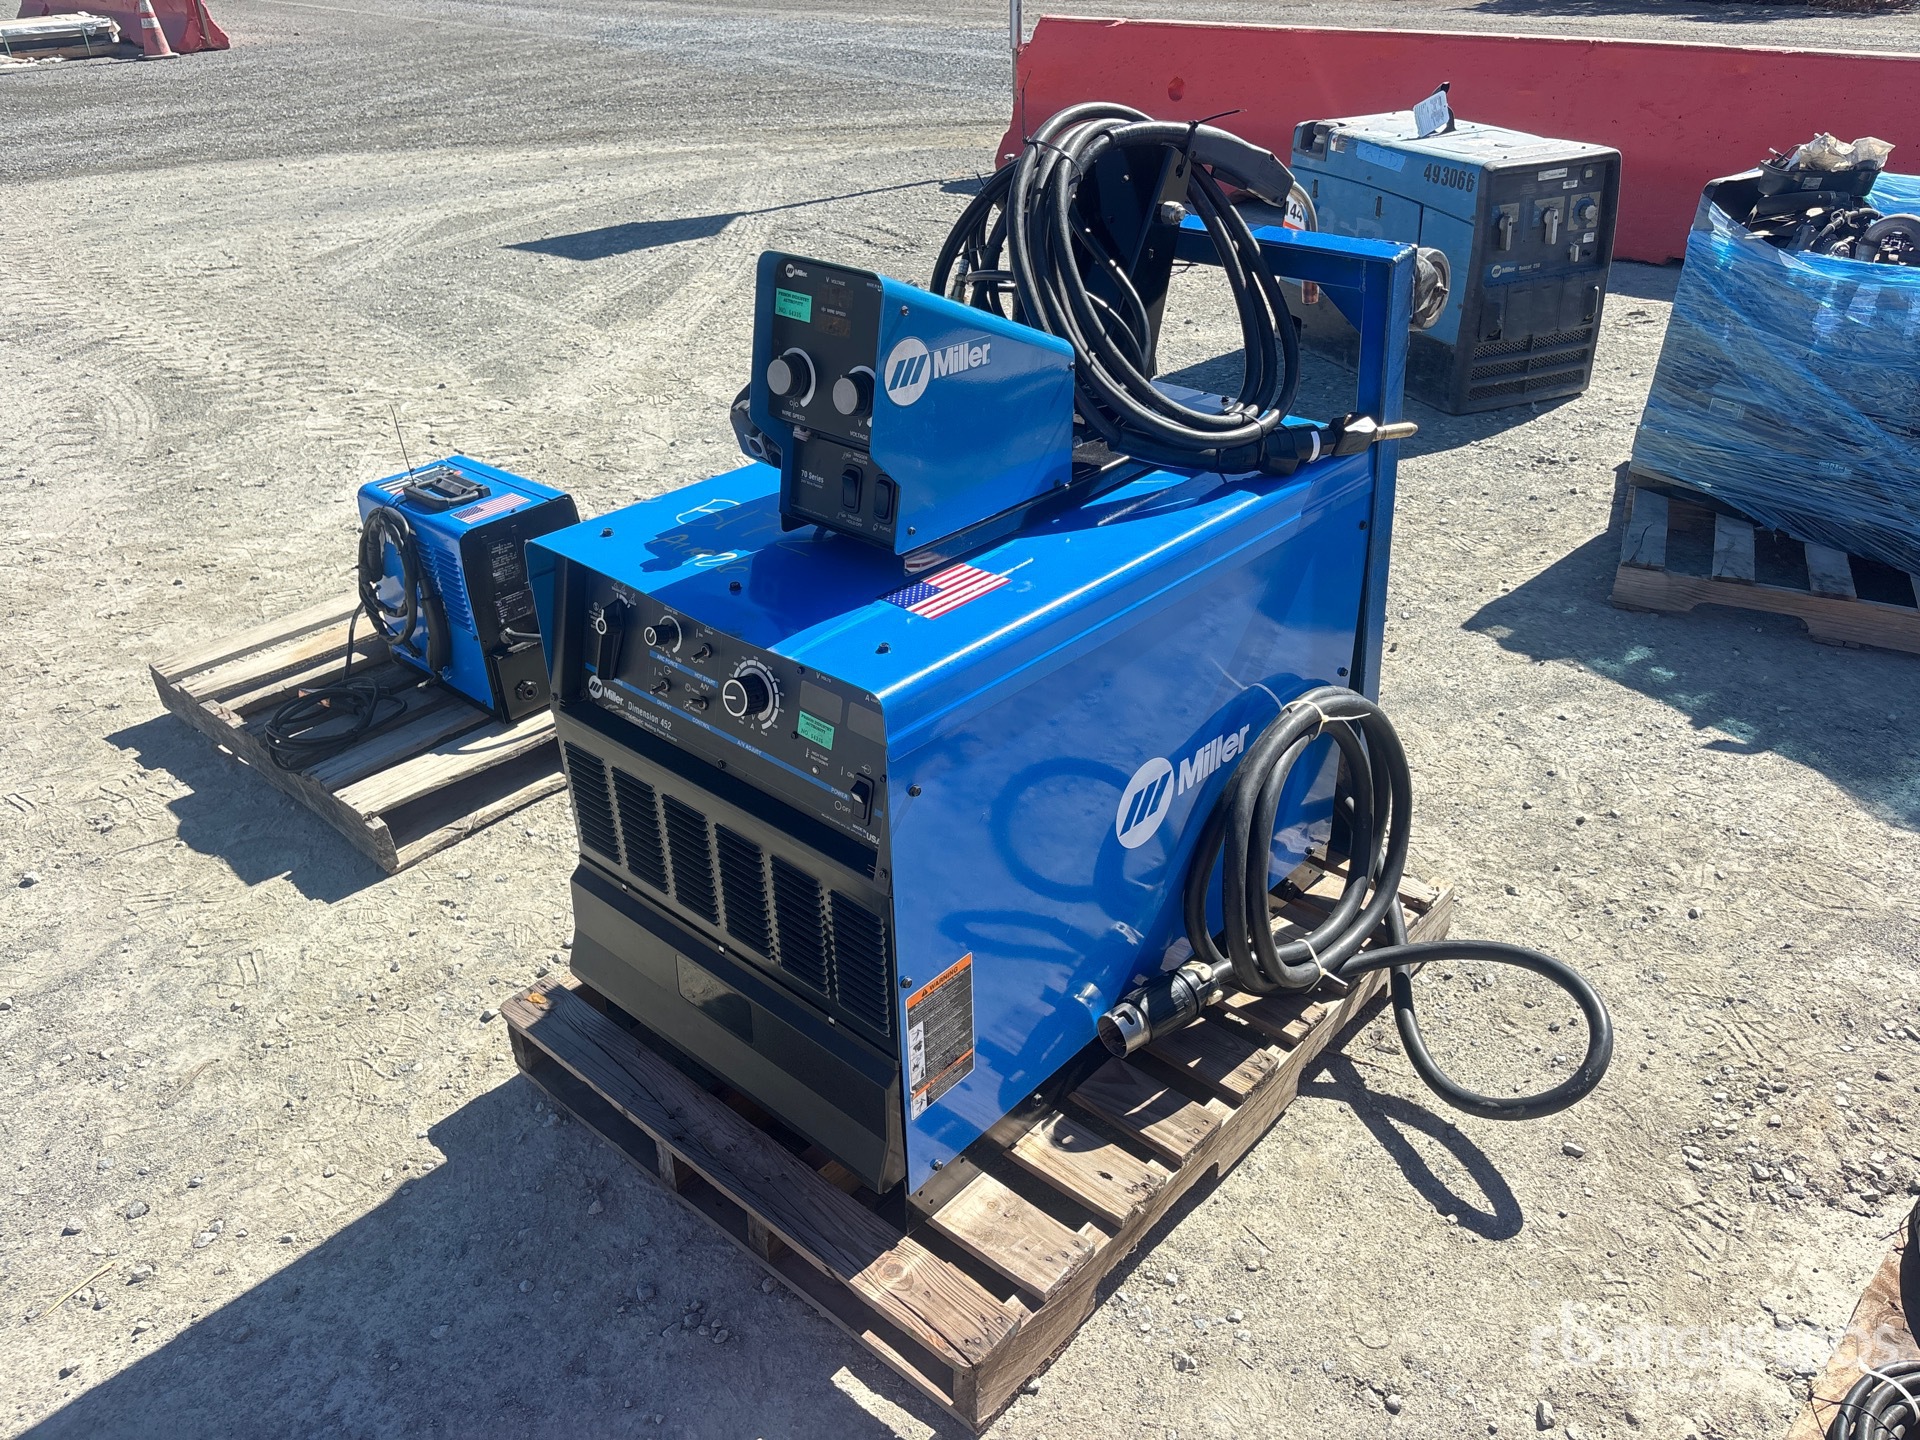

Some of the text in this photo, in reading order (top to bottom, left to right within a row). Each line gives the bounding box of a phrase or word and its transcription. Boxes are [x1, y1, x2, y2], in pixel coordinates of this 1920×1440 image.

[1423, 163, 1476, 193] 493066
[794, 268, 808, 278] Miller
[831, 278, 846, 287] VOLTAGE
[933, 342, 992, 380] Miller
[782, 409, 806, 422] WIRE SPEED
[849, 430, 869, 440] VOLTAGE
[801, 469, 824, 483] 70 Series
[656, 654, 679, 669] ARC FORCE
[694, 671, 716, 686] HOT START
[816, 671, 821, 680] V
[700, 682, 710, 691] A/V
[603, 686, 625, 706] Miller
[656, 699, 672, 711] OUTPUT
[627, 701, 672, 731] Dimension 452
[691, 717, 711, 730] CONTROL
[745, 743, 761, 755] ADJUST
[1177, 723, 1251, 797] Miller
[846, 771, 855, 779] ON
[830, 786, 848, 800] POWER
[842, 805, 851, 814] OFF
[929, 966, 959, 991] WARNING
